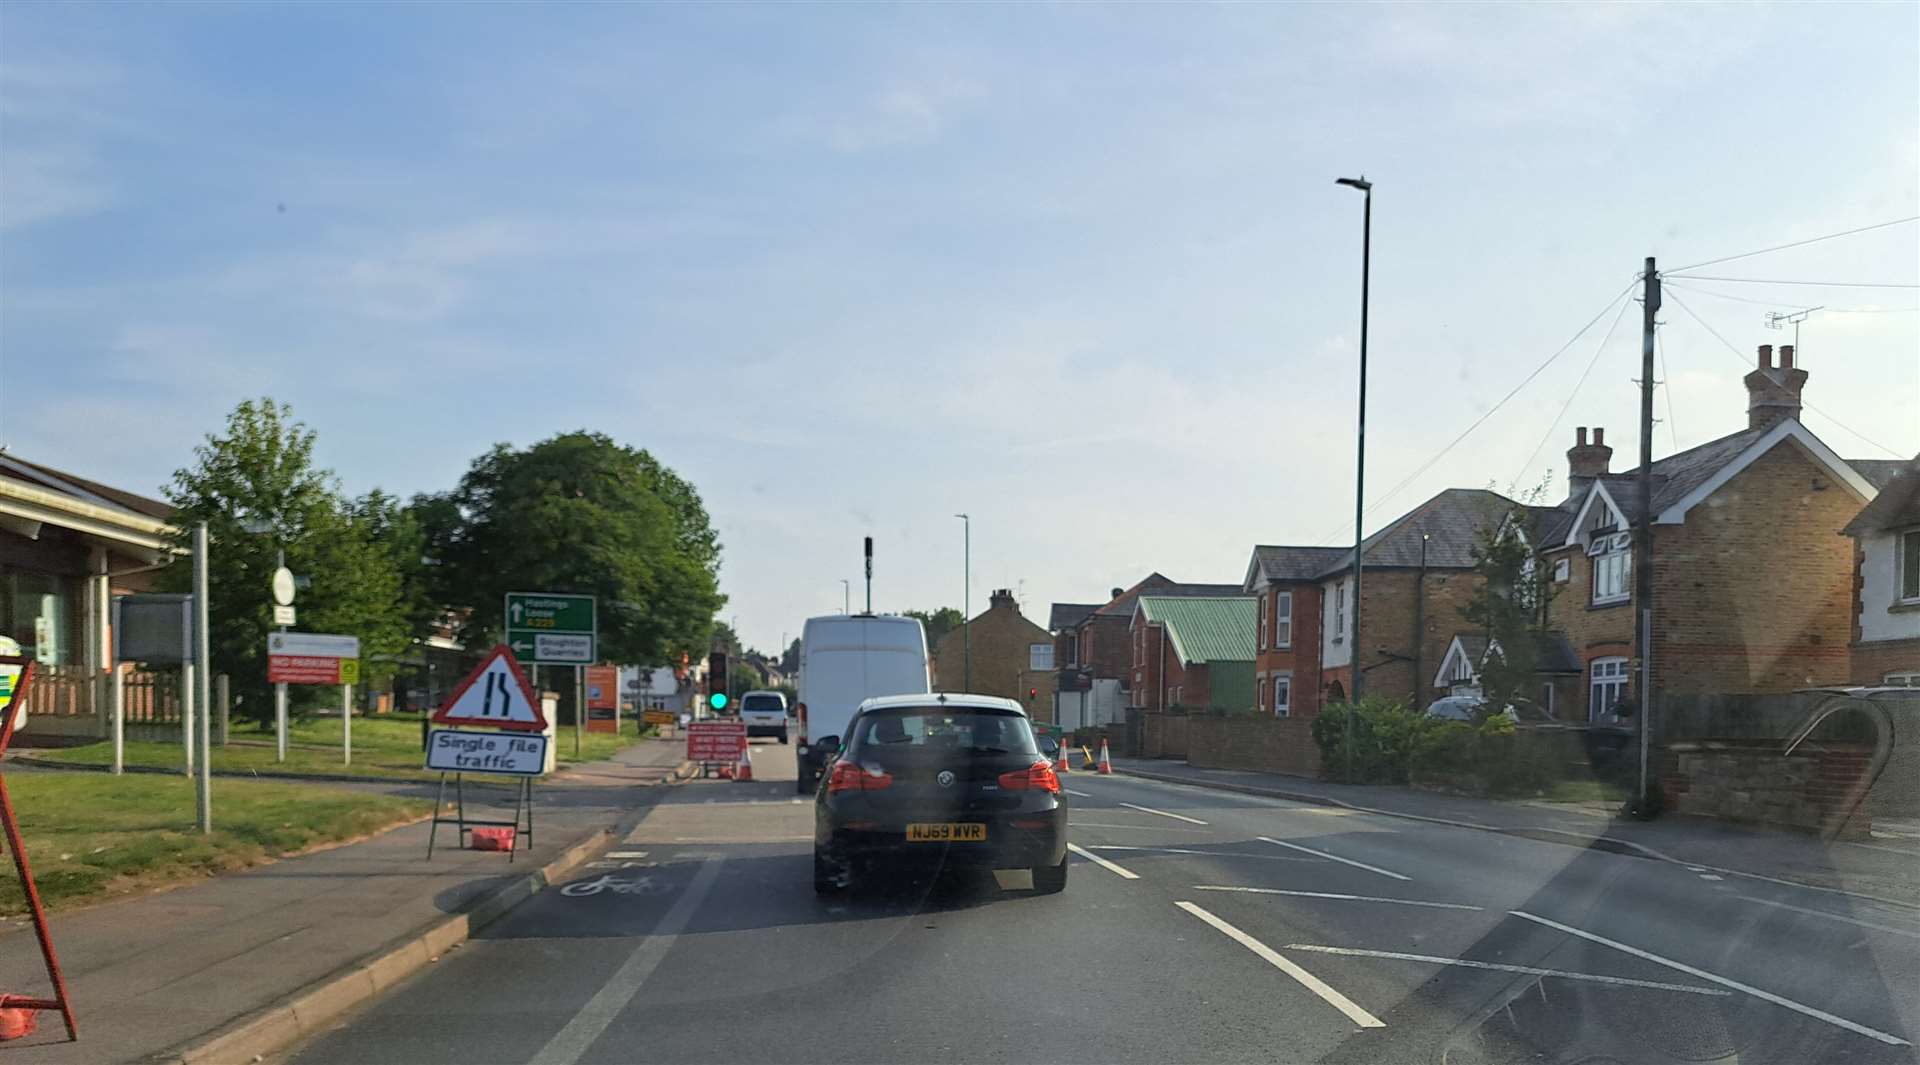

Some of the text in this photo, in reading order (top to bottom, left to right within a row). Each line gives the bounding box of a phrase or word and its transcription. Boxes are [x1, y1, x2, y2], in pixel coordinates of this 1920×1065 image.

[539, 637, 587, 648] Boughton
[438, 735, 538, 755] Single file
[456, 754, 517, 769] traffic
